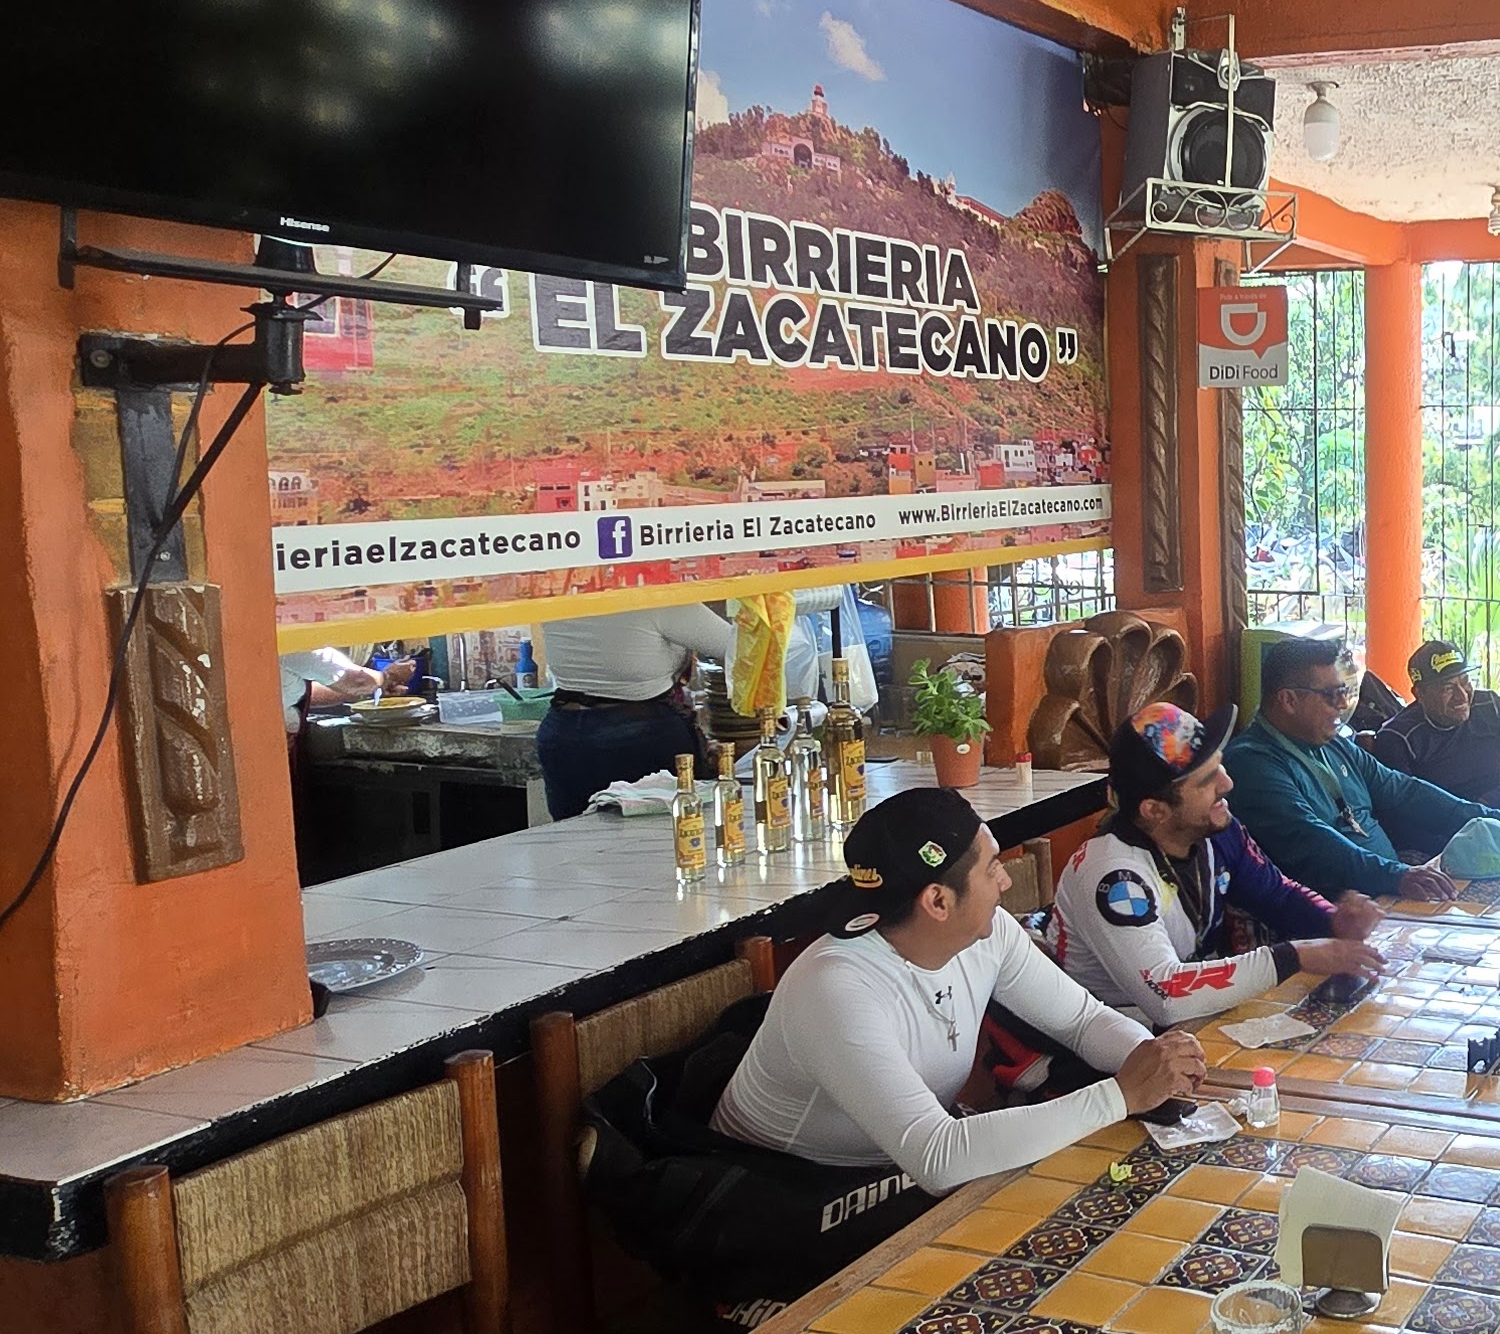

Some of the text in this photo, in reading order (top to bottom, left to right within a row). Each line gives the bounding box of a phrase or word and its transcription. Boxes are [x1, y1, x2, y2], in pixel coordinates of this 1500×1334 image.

[280, 216, 330, 233] Hisense
[687, 204, 980, 312] BIRRIERIA
[531, 273, 646, 358] EL
[1209, 364, 1278, 380] DiDi Food
[898, 496, 1104, 525] www.BirrieriaElZacatecano.com
[639, 513, 876, 546] Birrieria El Zacatecano
[275, 529, 581, 571] ieriaelzacatecano
